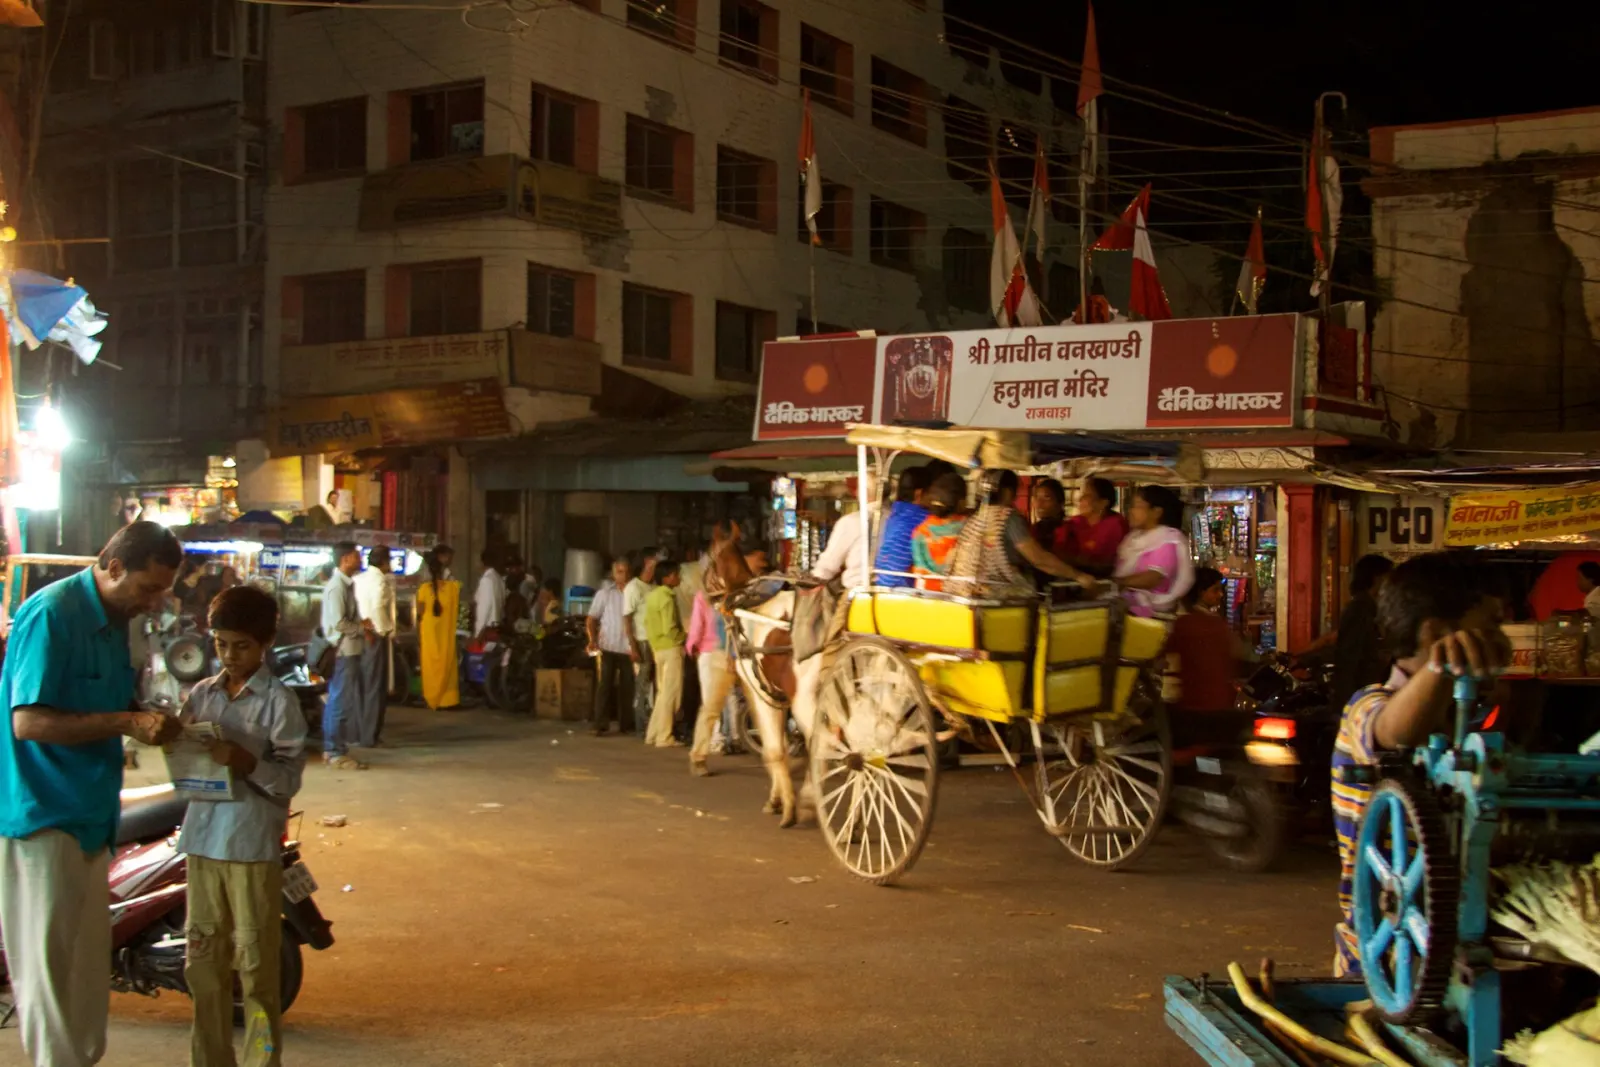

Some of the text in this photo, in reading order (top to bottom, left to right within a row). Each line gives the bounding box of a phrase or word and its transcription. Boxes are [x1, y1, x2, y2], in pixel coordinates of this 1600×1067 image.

[968, 330, 1142, 365] श्री प्राचीन वनखण्डी
[993, 369, 1109, 409] हनुमान मंदिर
[1157, 386, 1284, 412] दैनिक भास्कर
[764, 401, 865, 424] दैनिक भास्कर
[1025, 407, 1072, 420] राजवाड़ा
[1368, 506, 1433, 544] PCO
[1452, 500, 1522, 524] बालाजी
